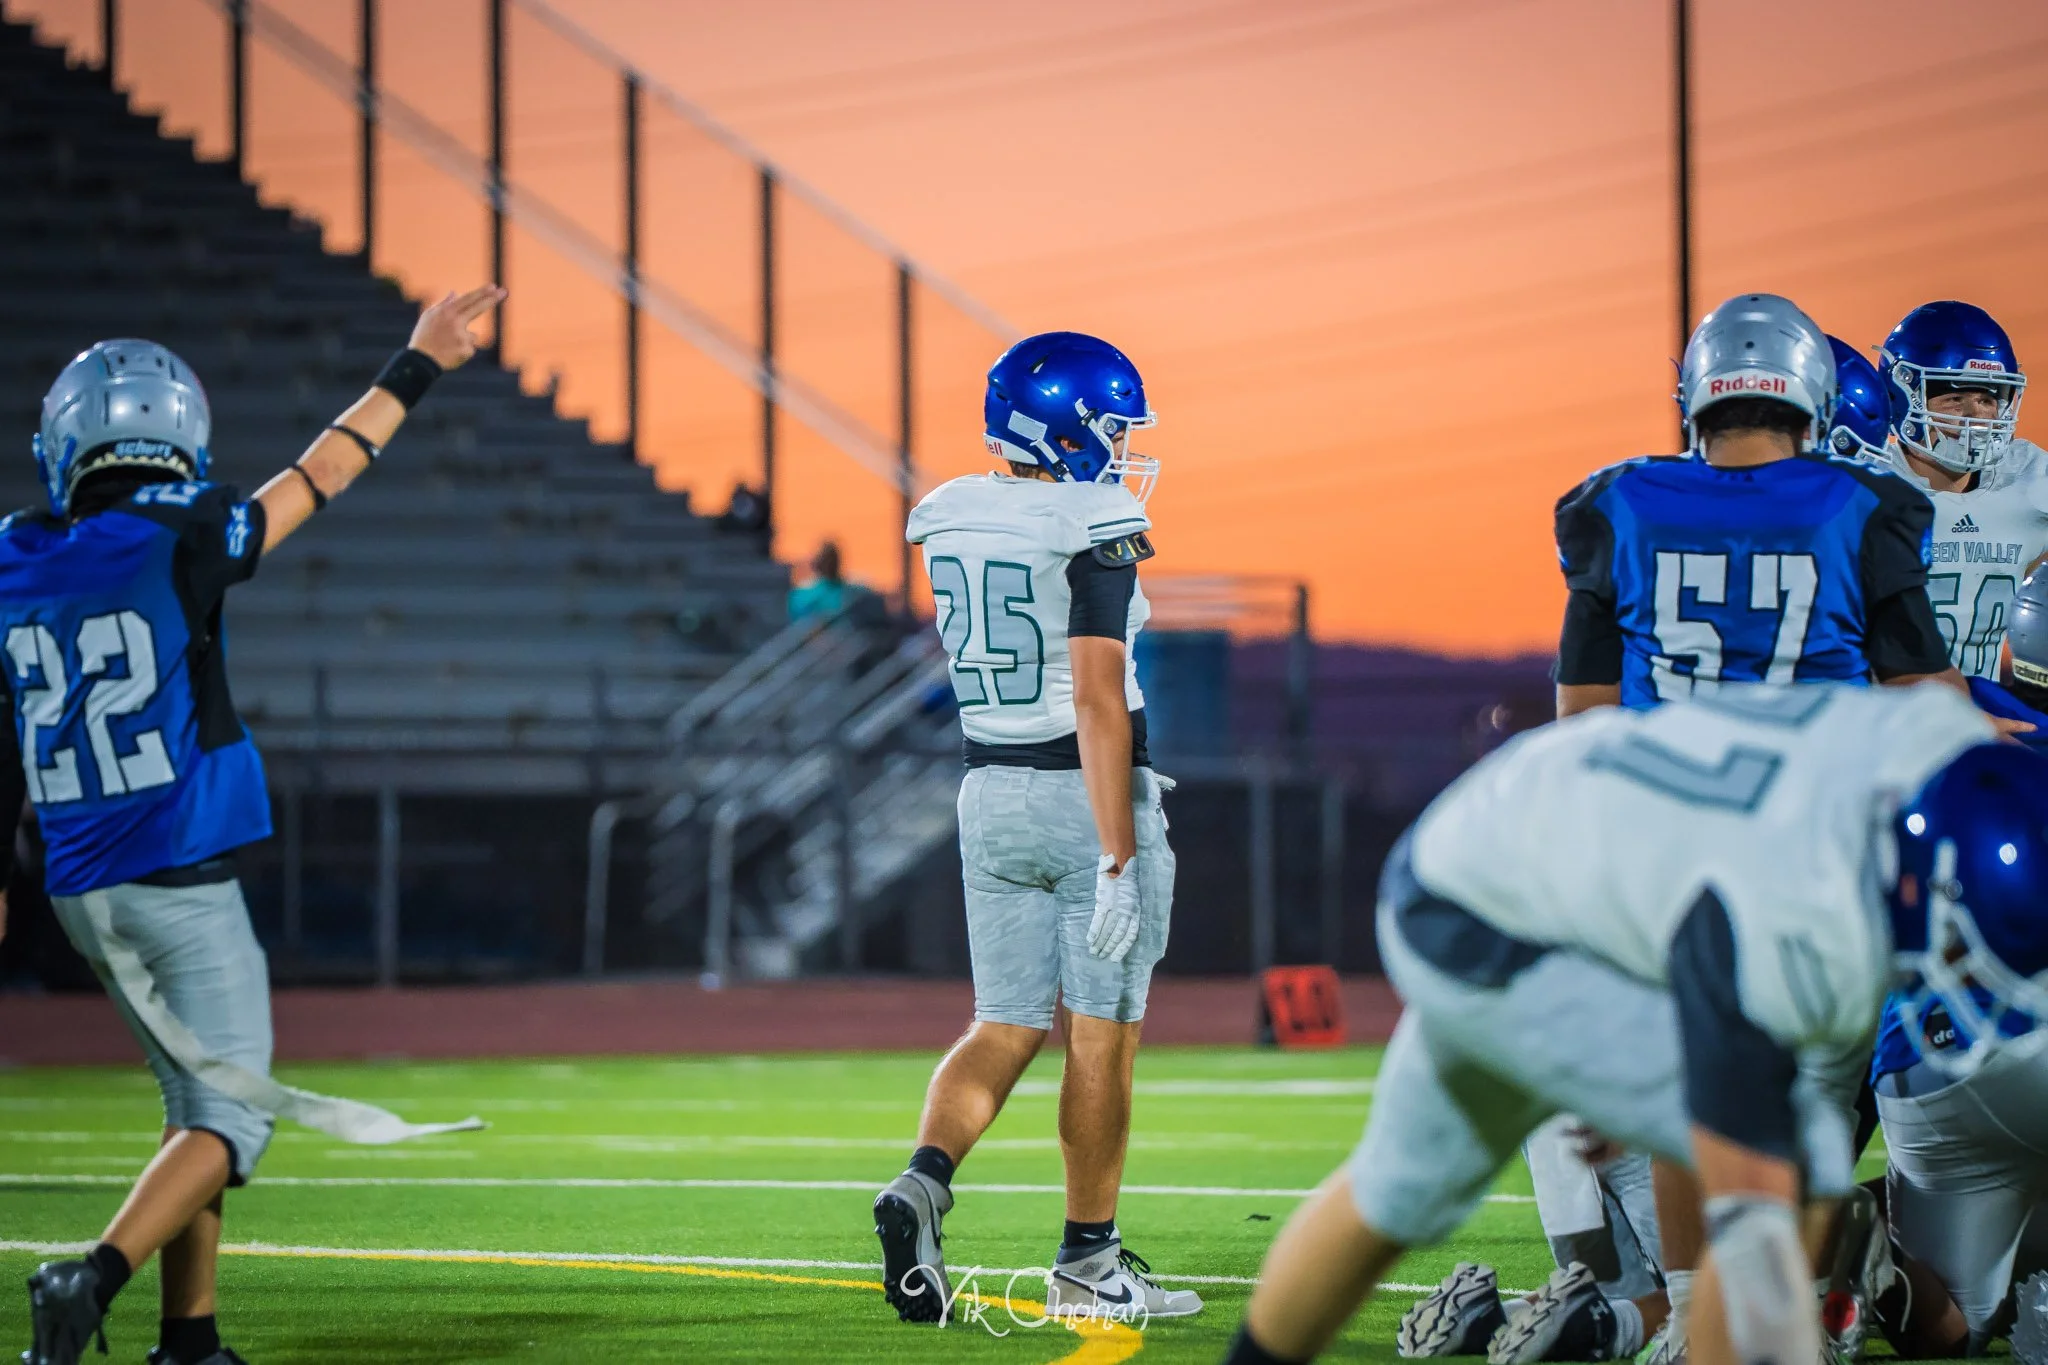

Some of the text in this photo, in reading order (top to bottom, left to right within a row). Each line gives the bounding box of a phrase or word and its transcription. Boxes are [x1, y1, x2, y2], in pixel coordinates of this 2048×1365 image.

[1710, 377, 1786, 395] Riddell
[1931, 542, 2022, 565] EEN VALLEY
[1951, 525, 1979, 533] adidas
[930, 556, 1045, 706] 25
[1649, 552, 1818, 702] 57
[1926, 572, 2016, 682] 50
[5, 610, 176, 803] 22
